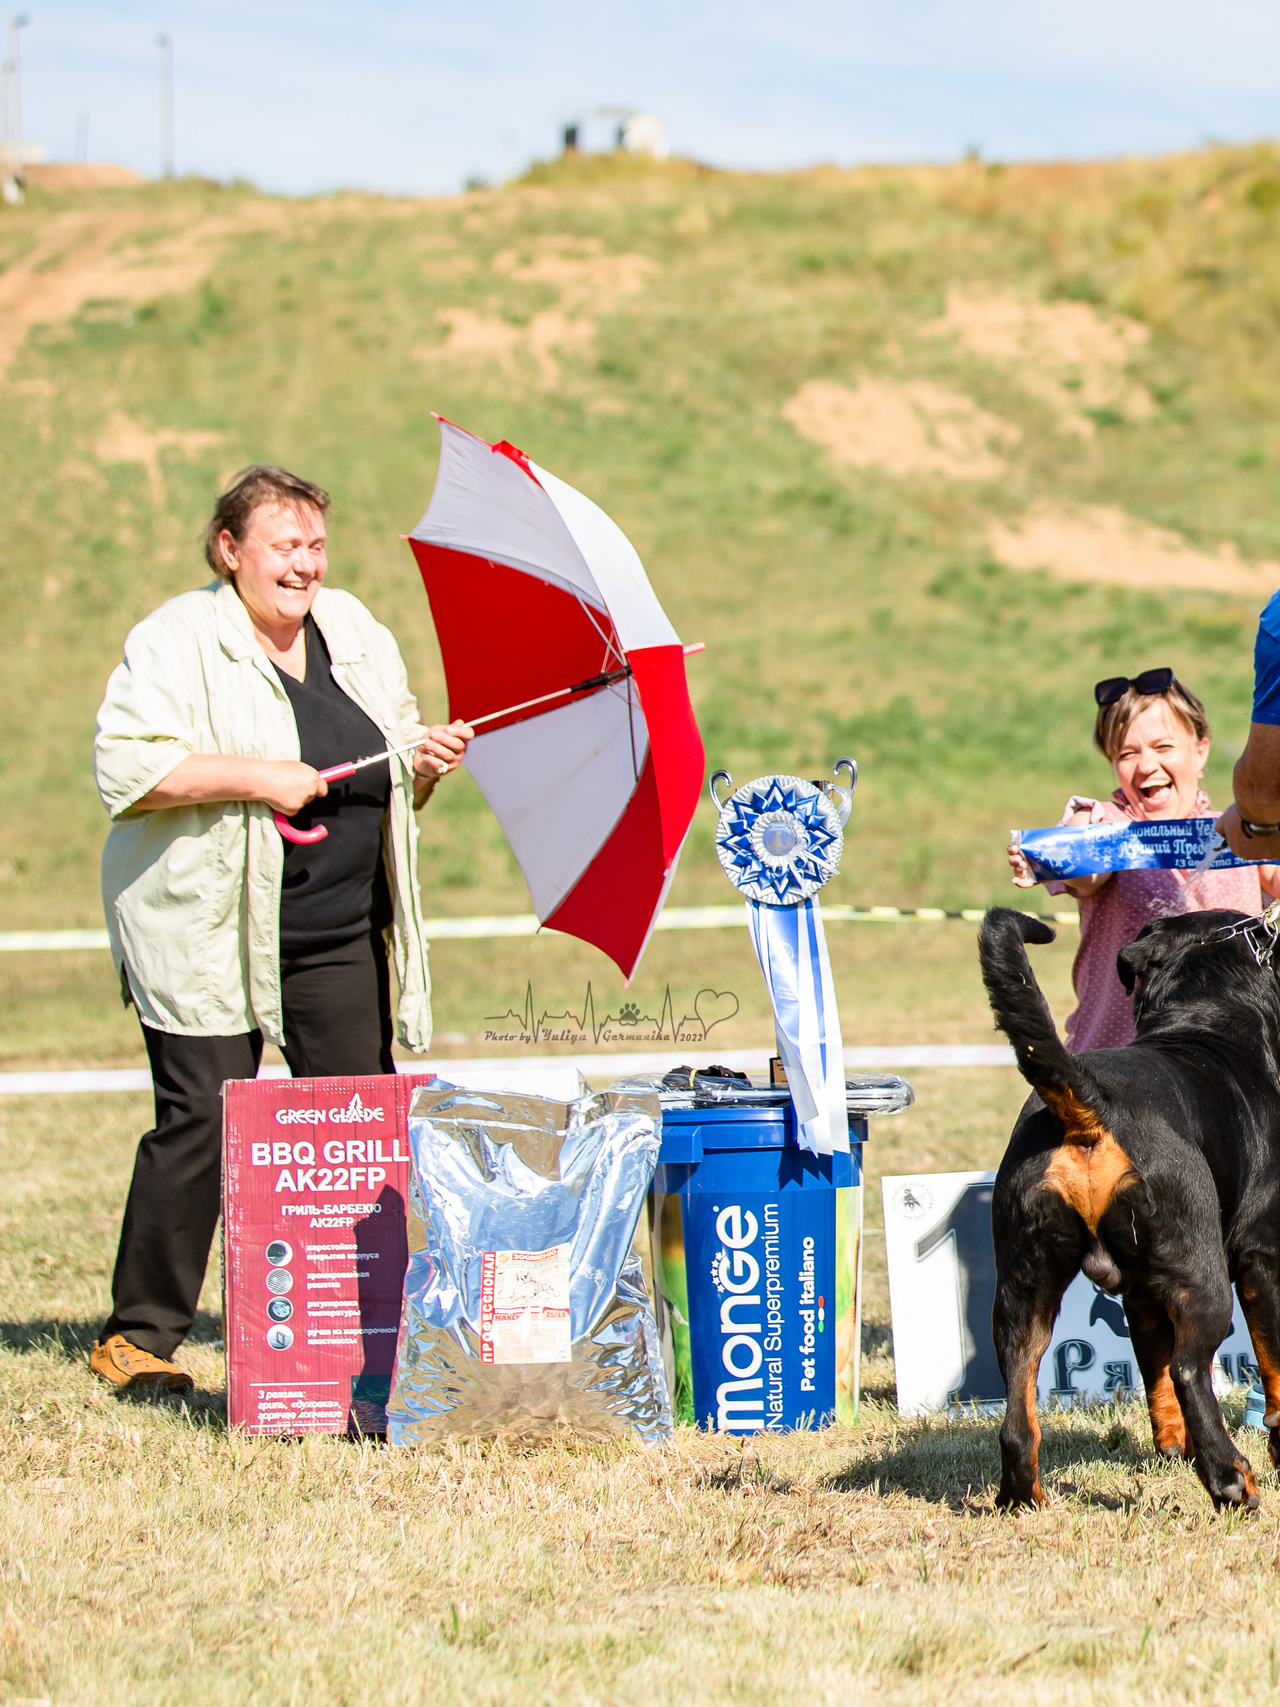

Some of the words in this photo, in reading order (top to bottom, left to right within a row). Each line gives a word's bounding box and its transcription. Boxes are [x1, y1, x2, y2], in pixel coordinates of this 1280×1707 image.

[1174, 859, 1186, 867] 13
[275, 1108, 326, 1125] GREEN
[328, 1099, 385, 1124] GLADE
[251, 1140, 316, 1166] BBQ
[323, 1139, 410, 1164] GRILL
[274, 1166, 387, 1193] AK22FP
[281, 1202, 383, 1216] ГРИЛЬ-БАРБЕКЮ
[309, 1217, 355, 1229] AK22FP
[763, 1203, 784, 1350] Superpremium
[799, 1236, 816, 1305] italiano
[482, 1253, 495, 1363] ПРОФЕССИОНАЛ
[914, 1181, 1028, 1404] 1
[799, 1309, 816, 1356] food
[800, 1357, 816, 1392] Pet
[258, 1390, 265, 1399] 3
[765, 1357, 784, 1429] Natural
